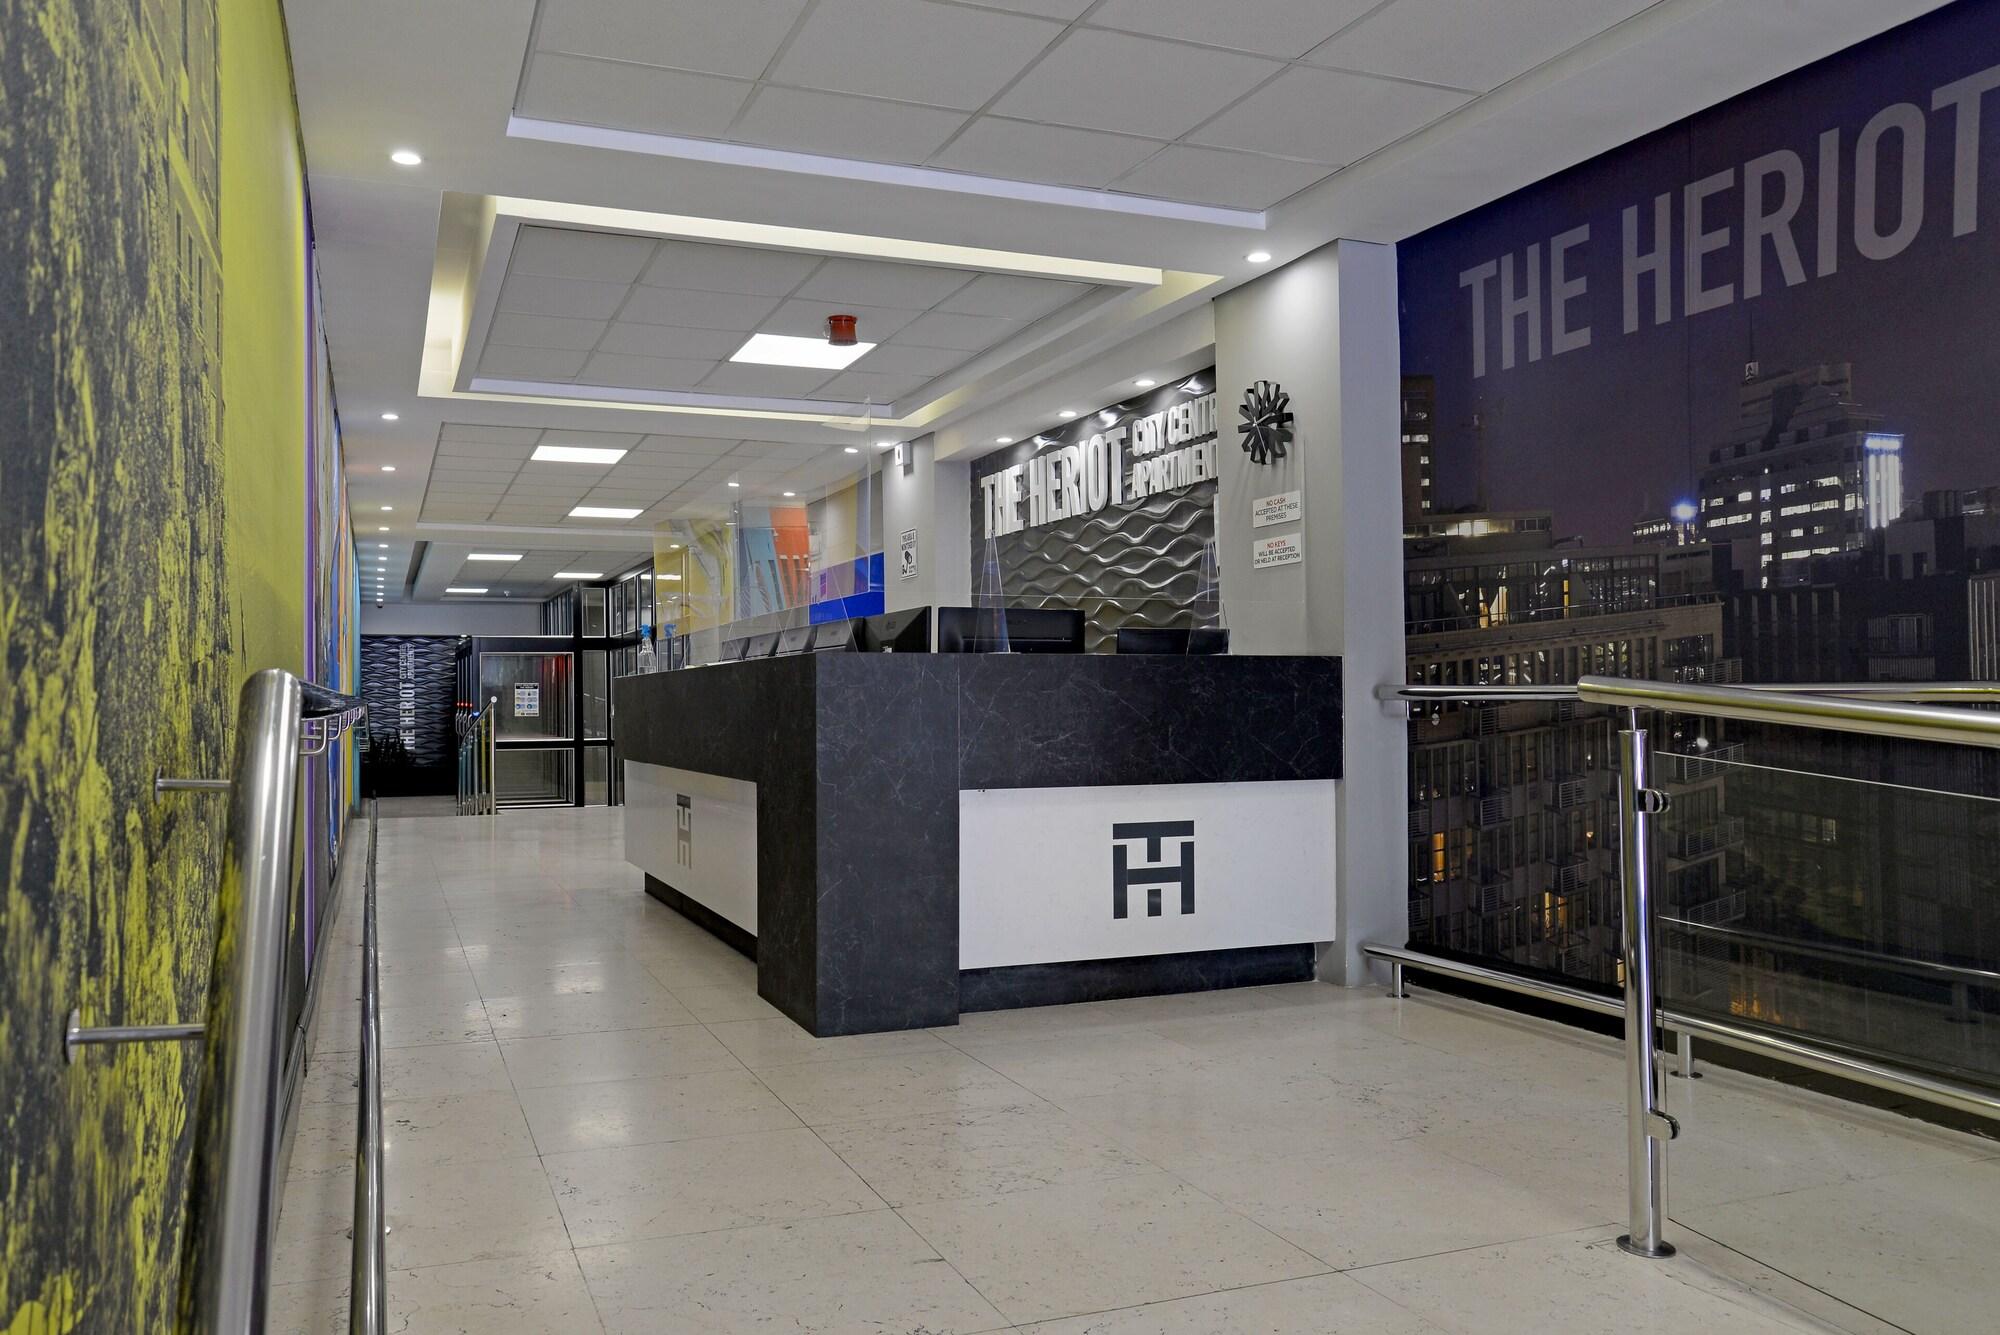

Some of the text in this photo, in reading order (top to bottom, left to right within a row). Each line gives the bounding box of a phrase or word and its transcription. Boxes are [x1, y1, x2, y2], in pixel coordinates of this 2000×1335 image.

[1459, 63, 2000, 378] THE HERIOT
[1132, 411, 1168, 457] CITY
[981, 426, 1127, 540] THE HERIOT
[1273, 497, 1286, 505] CASH
[1255, 506, 1278, 516] ACCEPTED
[1284, 502, 1298, 510] THESE
[1266, 512, 1287, 521] PREMISES
[1274, 540, 1287, 548] KEYS
[1274, 545, 1296, 554] ACCEPTED
[1260, 556, 1271, 564] HELD
[1271, 554, 1277, 562] AT
[1277, 552, 1300, 561] RECEPTION
[400, 681, 415, 725] HERIOT
